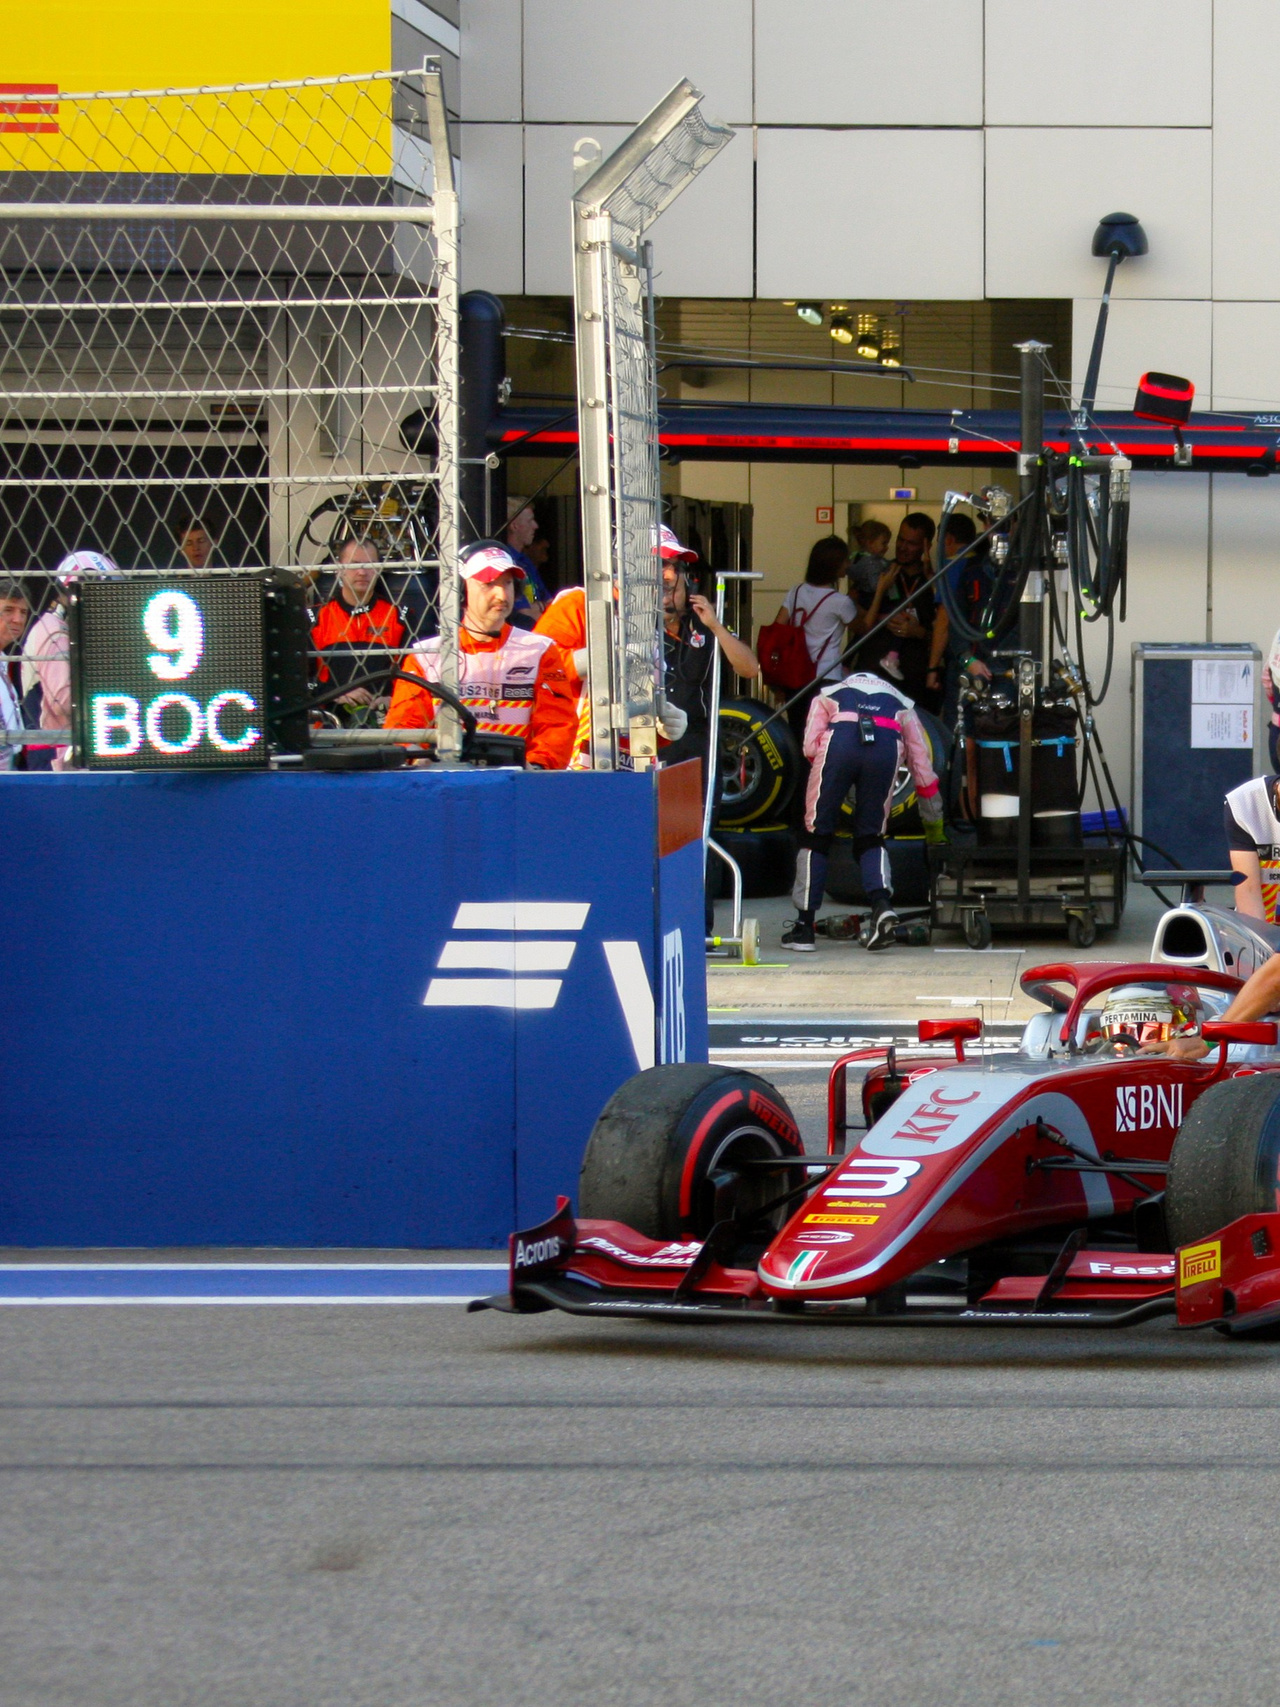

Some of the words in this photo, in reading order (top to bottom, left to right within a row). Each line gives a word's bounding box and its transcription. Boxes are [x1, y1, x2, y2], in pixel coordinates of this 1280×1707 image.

[143, 590, 204, 680] 9
[92, 692, 261, 757] BOC
[751, 721, 784, 771] PRELLI
[1104, 1012, 1158, 1024] PERTAMINA
[748, 1089, 799, 1147] PIRELLI
[890, 1086, 981, 1144] KFC
[1140, 1083, 1184, 1130] BNI
[823, 1159, 922, 1197] 3
[515, 1236, 560, 1269] Acronis
[1183, 1249, 1217, 1279] PIRELLI
